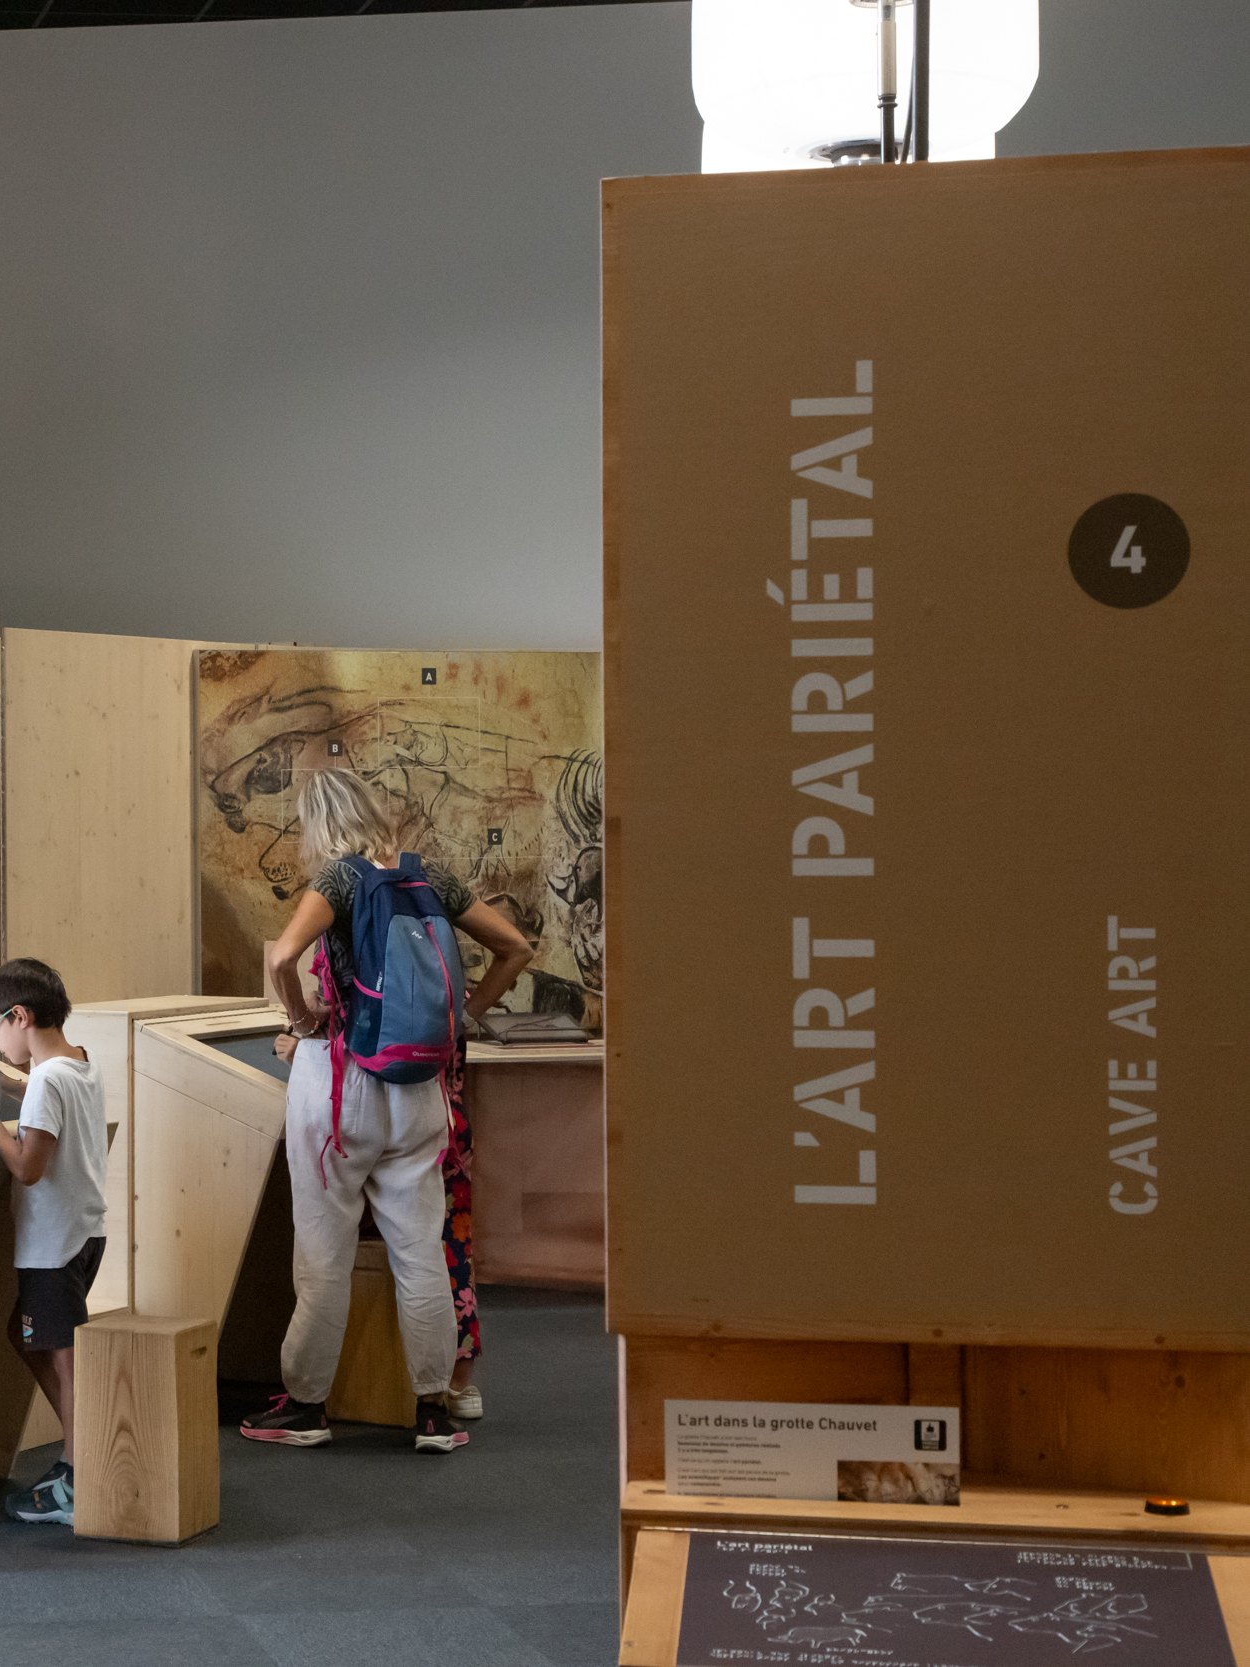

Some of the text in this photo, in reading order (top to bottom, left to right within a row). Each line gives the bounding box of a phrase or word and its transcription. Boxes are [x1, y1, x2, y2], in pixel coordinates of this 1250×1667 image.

[1110, 525, 1147, 574] 4
[332, 743, 339, 753] B
[766, 360, 877, 1205] L'ART PARIÉTAL
[491, 832, 498, 842] C
[1107, 915, 1159, 1215] CAVE ART
[677, 1413, 878, 1431] L'art dans la grotte Chauvet
